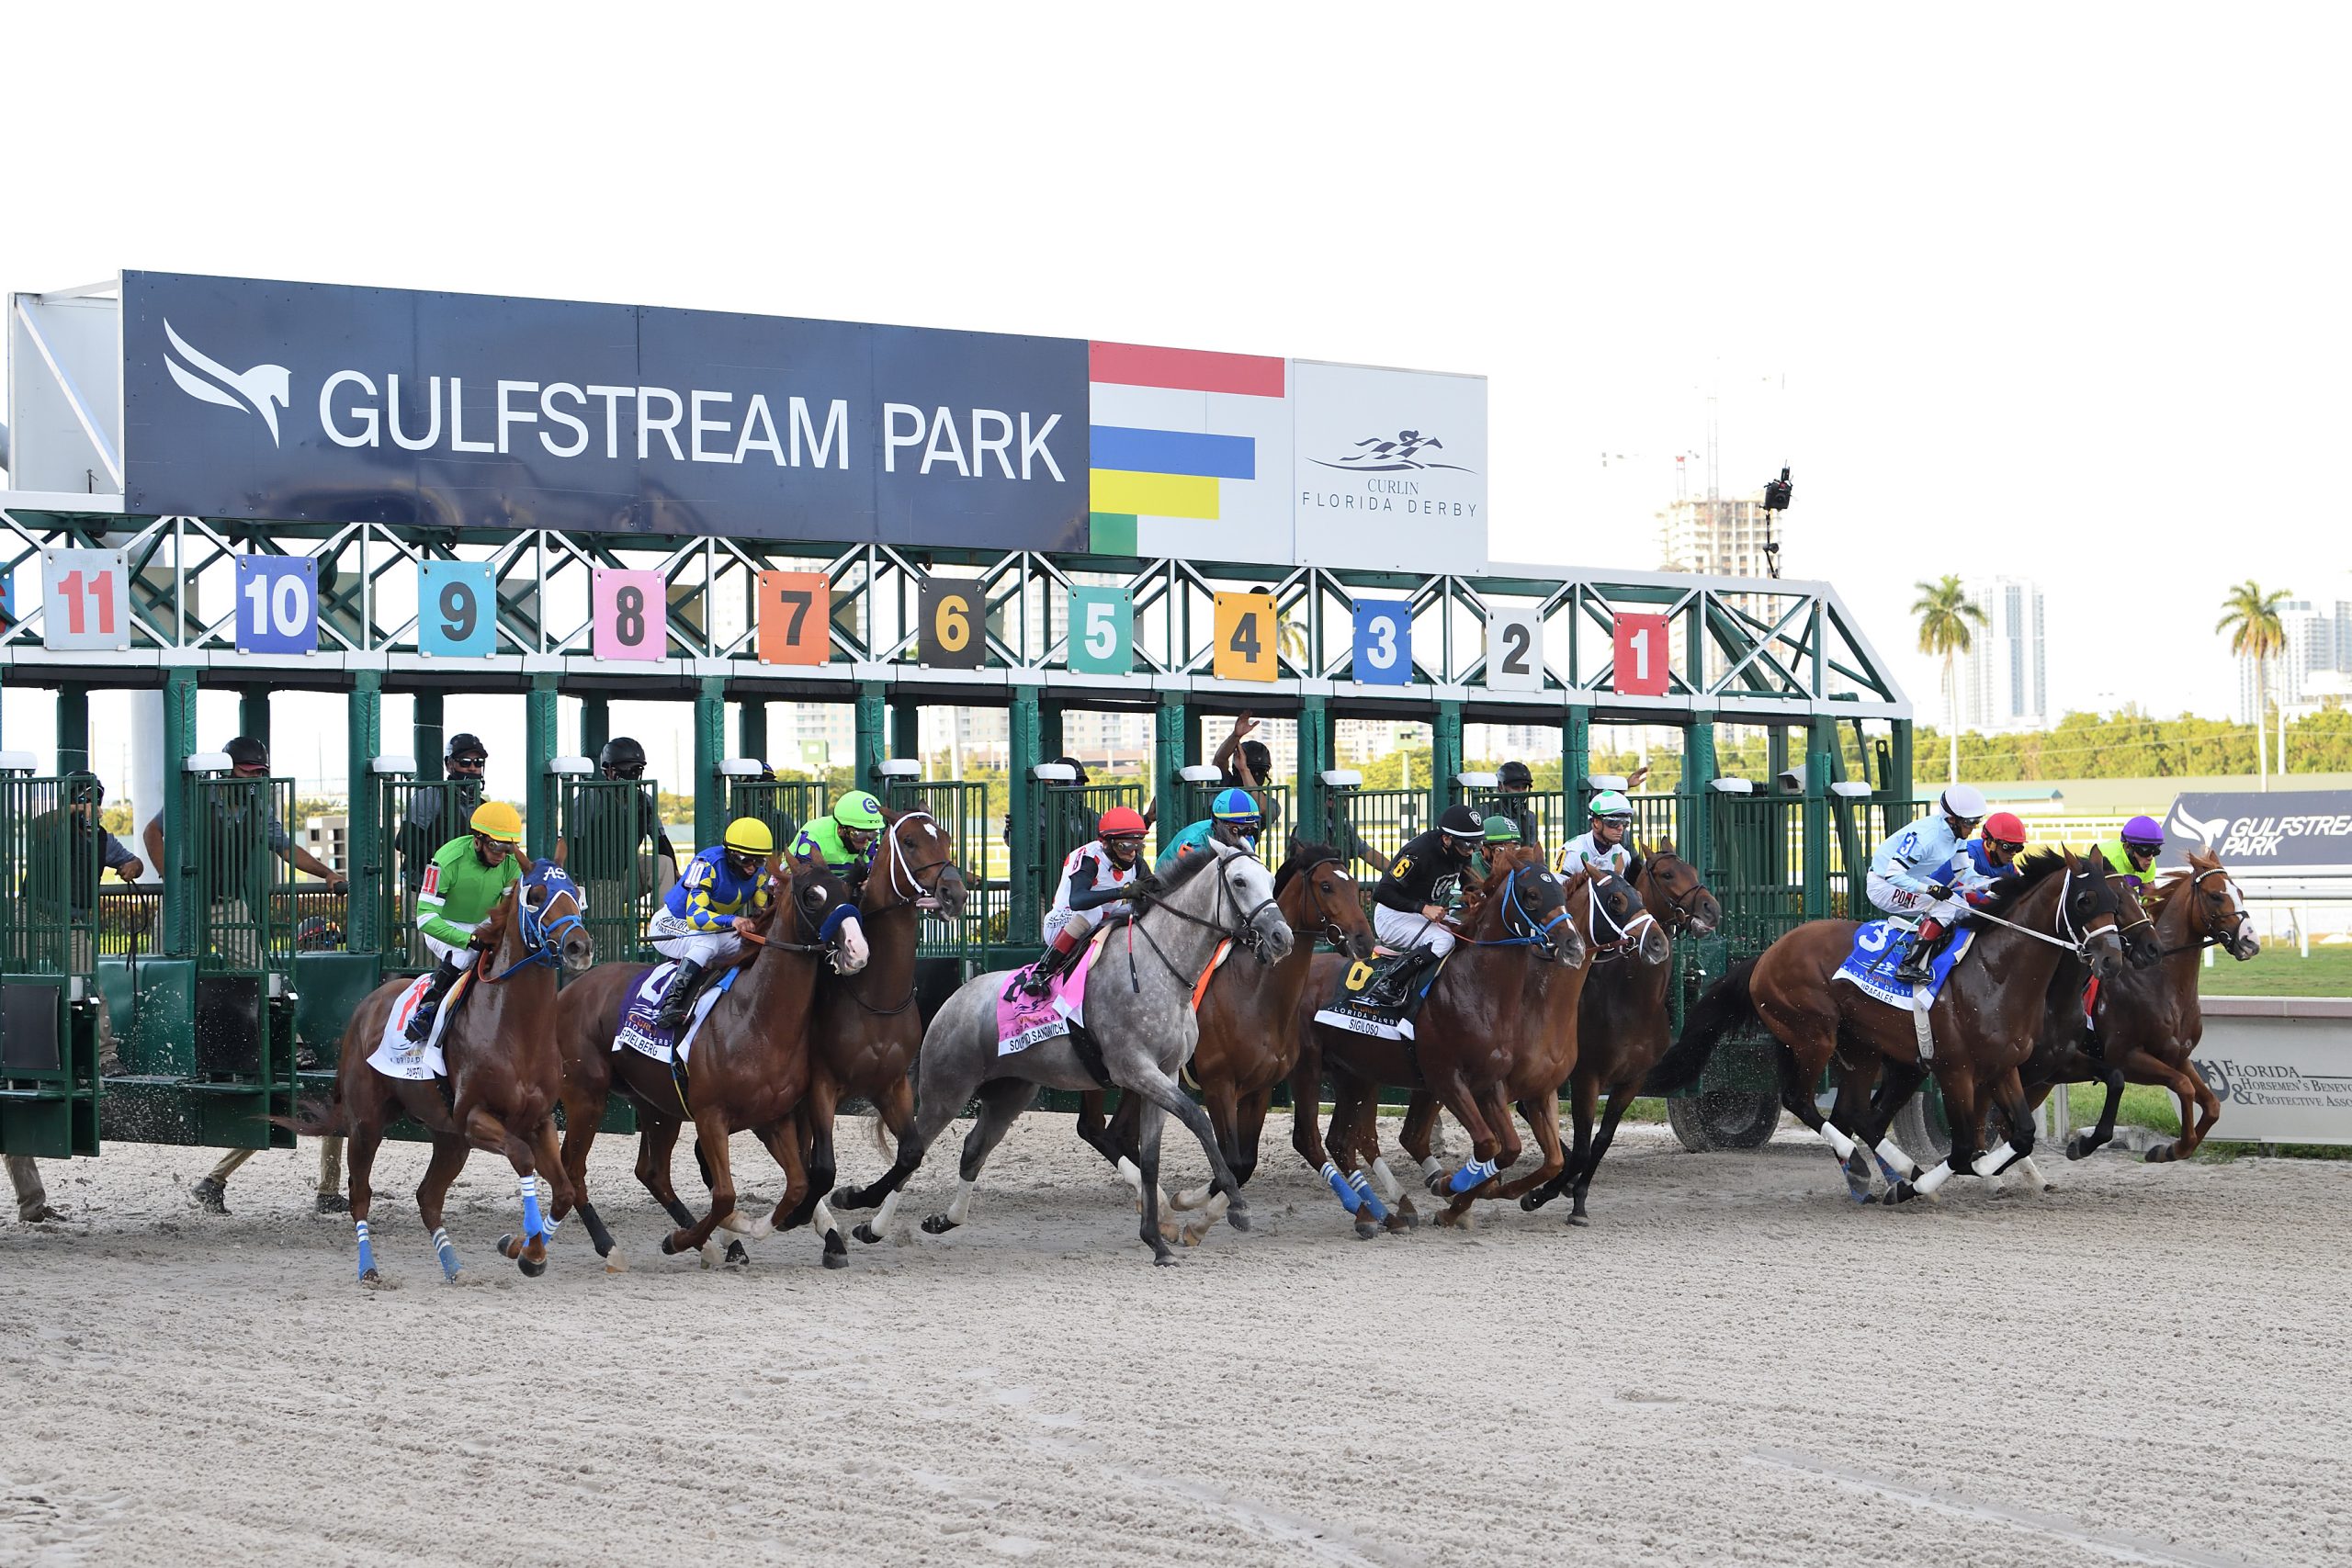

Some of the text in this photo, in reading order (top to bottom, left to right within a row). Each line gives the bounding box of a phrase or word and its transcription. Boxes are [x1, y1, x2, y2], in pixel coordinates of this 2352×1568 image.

[320, 369, 1066, 482] GULFSTREAM PARK
[1302, 491, 1477, 517] FLORIDA DERBY
[1367, 478, 1419, 495] CURLIN
[58, 570, 114, 634] 11
[244, 574, 310, 637] 10
[439, 581, 478, 642] 9
[616, 585, 645, 647] 8
[780, 590, 812, 647] 7
[935, 594, 970, 652] 6
[1084, 602, 1117, 660] 5
[1229, 612, 1261, 664] 4
[1366, 615, 1397, 670] 3
[1501, 623, 1531, 675] 2
[1630, 628, 1648, 680] 1
[1555, 852, 1565, 872] 4
[1900, 835, 1915, 856] 3
[2220, 836, 2284, 856] PARK
[423, 867, 439, 895] 11
[543, 866, 567, 881] AS
[684, 862, 706, 887] 10
[1392, 857, 1410, 879] 6
[619, 1029, 658, 1056] SPIELBERG
[2222, 1059, 2301, 1078] FLORIDA
[2231, 1083, 2257, 1105] &
[2256, 1093, 2324, 1107] PROTECTIVE
